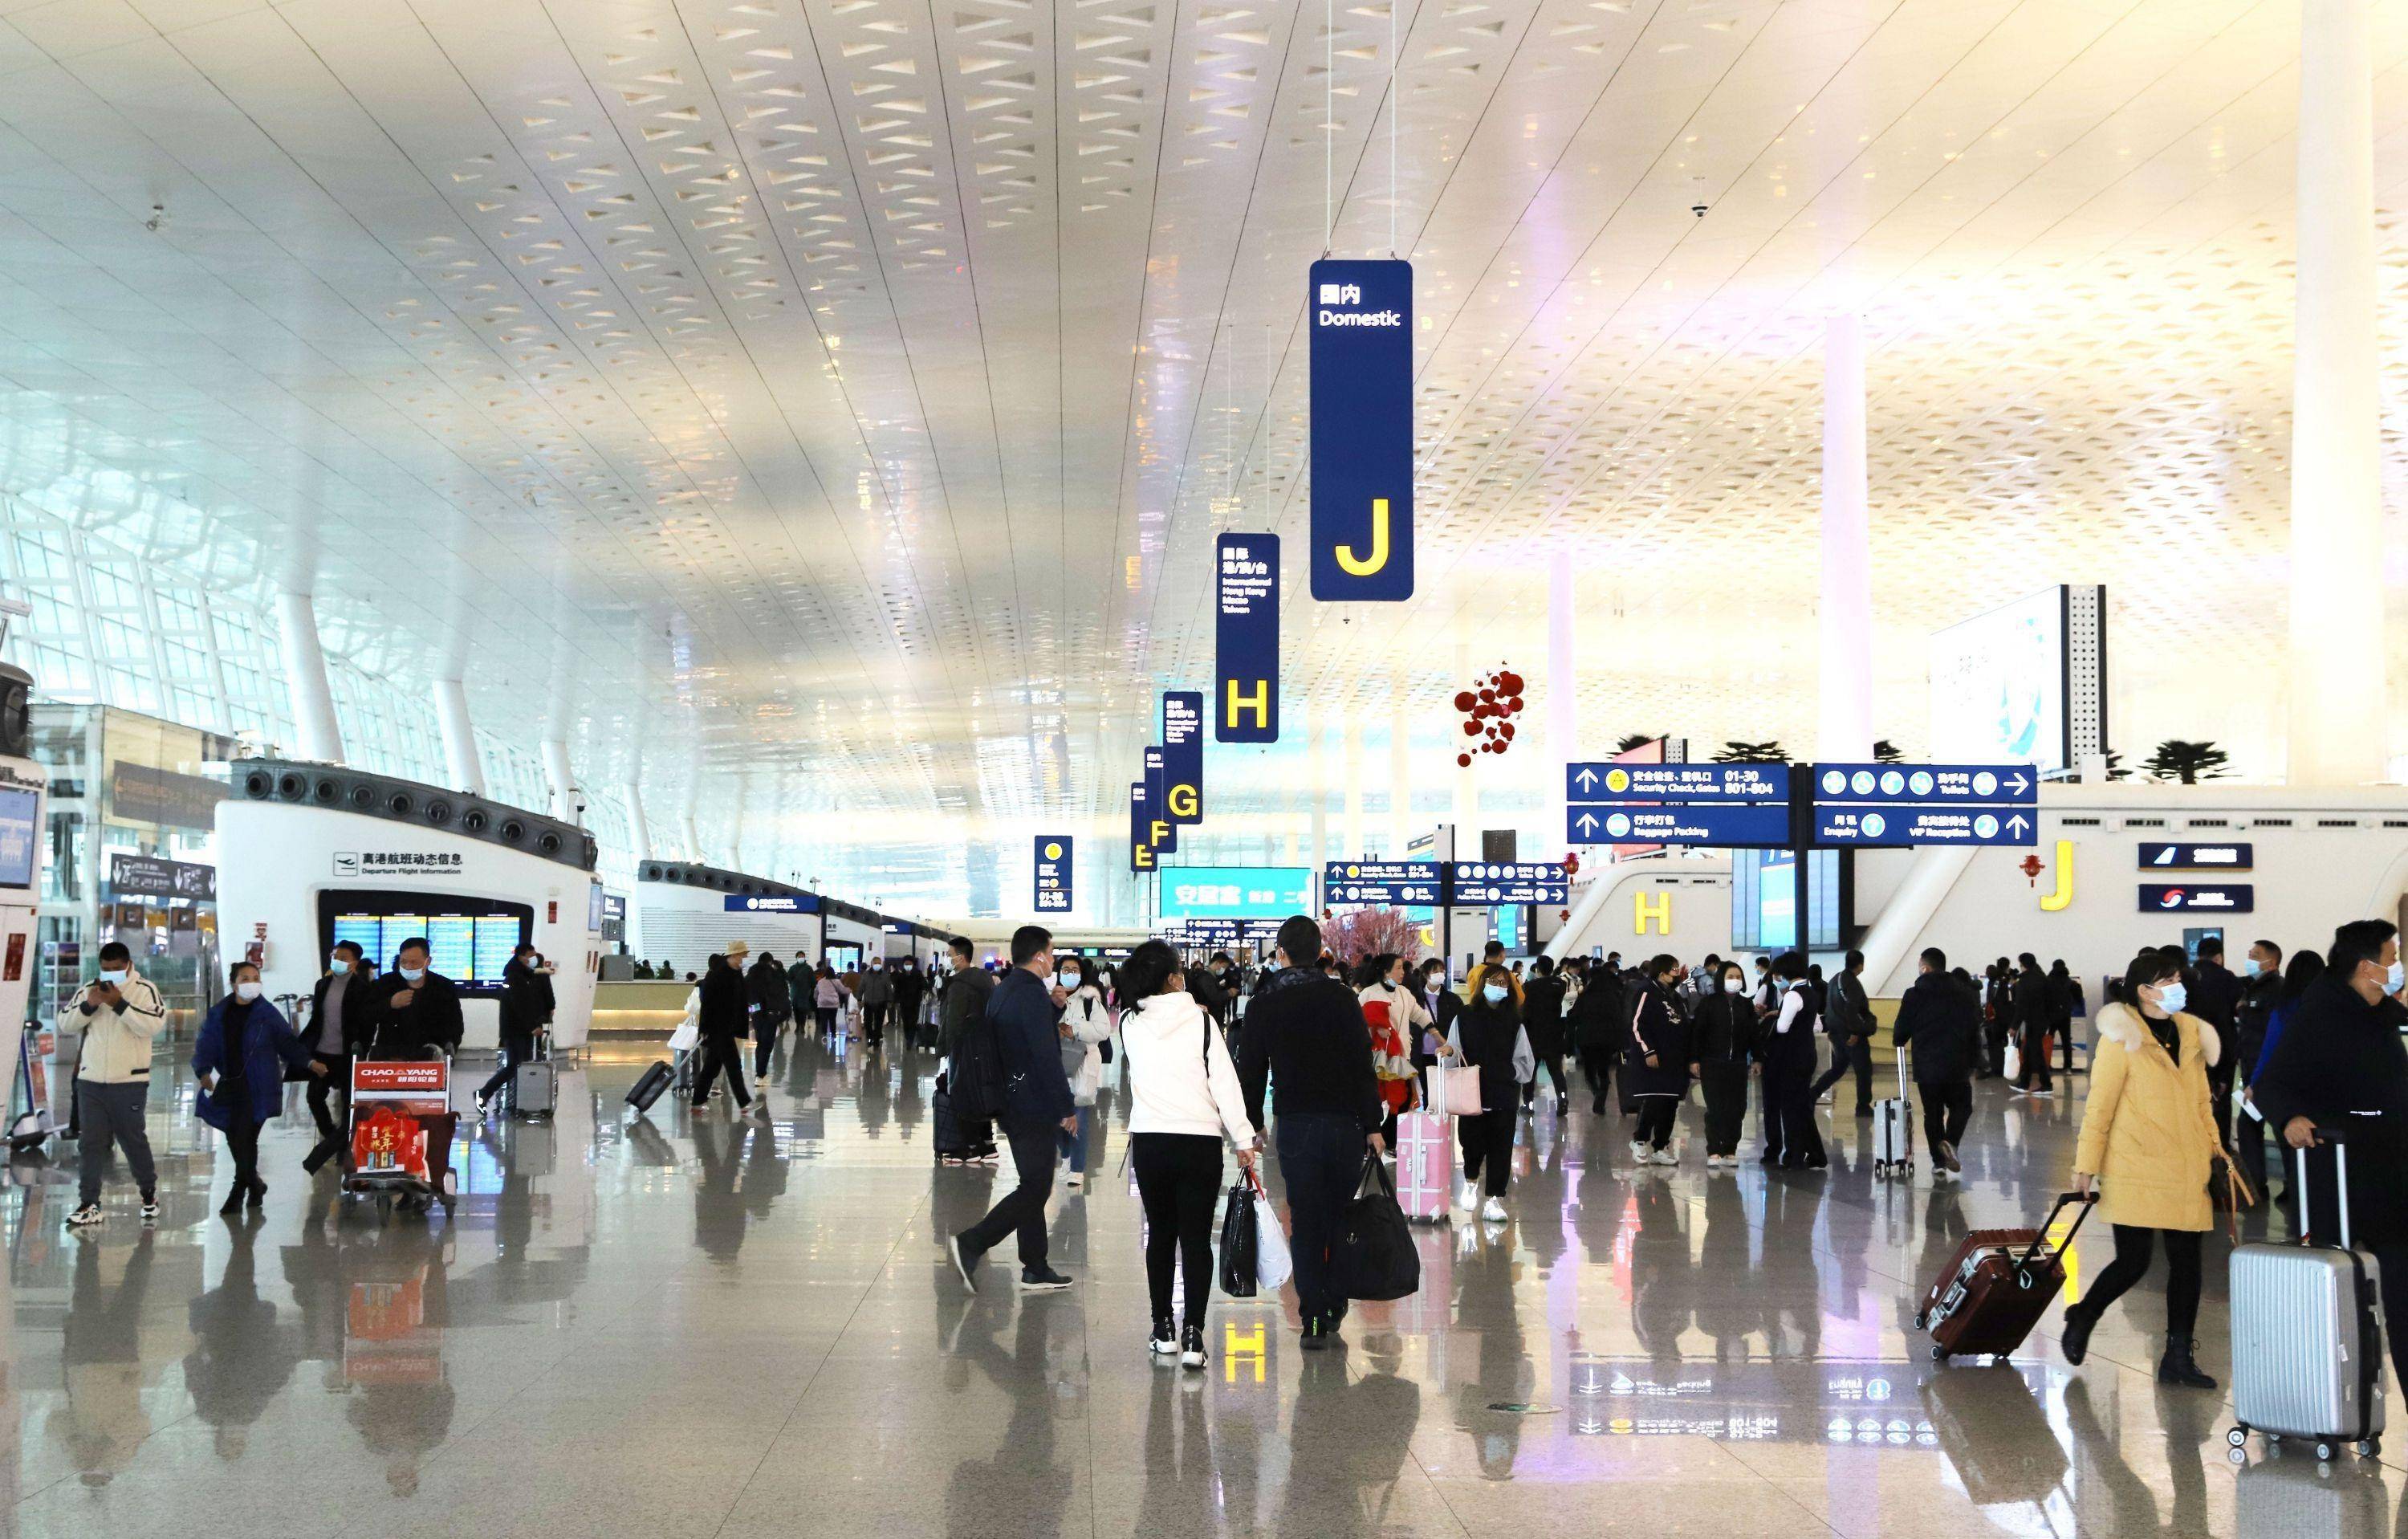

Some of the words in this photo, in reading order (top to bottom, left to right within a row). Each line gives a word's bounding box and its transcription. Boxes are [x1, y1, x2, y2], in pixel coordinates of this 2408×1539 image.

[1320, 283, 1361, 305] 国内
[1320, 310, 1401, 327] Domestic
[1336, 499, 1389, 576] J
[1227, 679, 1267, 728] H
[1724, 770, 1759, 782] 01-30
[1633, 783, 1667, 794] Security
[1695, 784, 1721, 793] Gates
[1939, 785, 1970, 795] Toilets
[1169, 784, 1198, 816] G
[1152, 821, 1169, 846] F
[1633, 827, 1673, 839] Baggage
[1674, 827, 1709, 838] Packing
[1824, 827, 1858, 838] Enquiry
[1909, 828, 1926, 837] VIP
[1926, 828, 1971, 839] Reception
[363, 853, 462, 865] 离港航班动态信息
[1136, 844, 1153, 866] E
[2040, 841, 2074, 912] J
[1634, 892, 1670, 935] H
